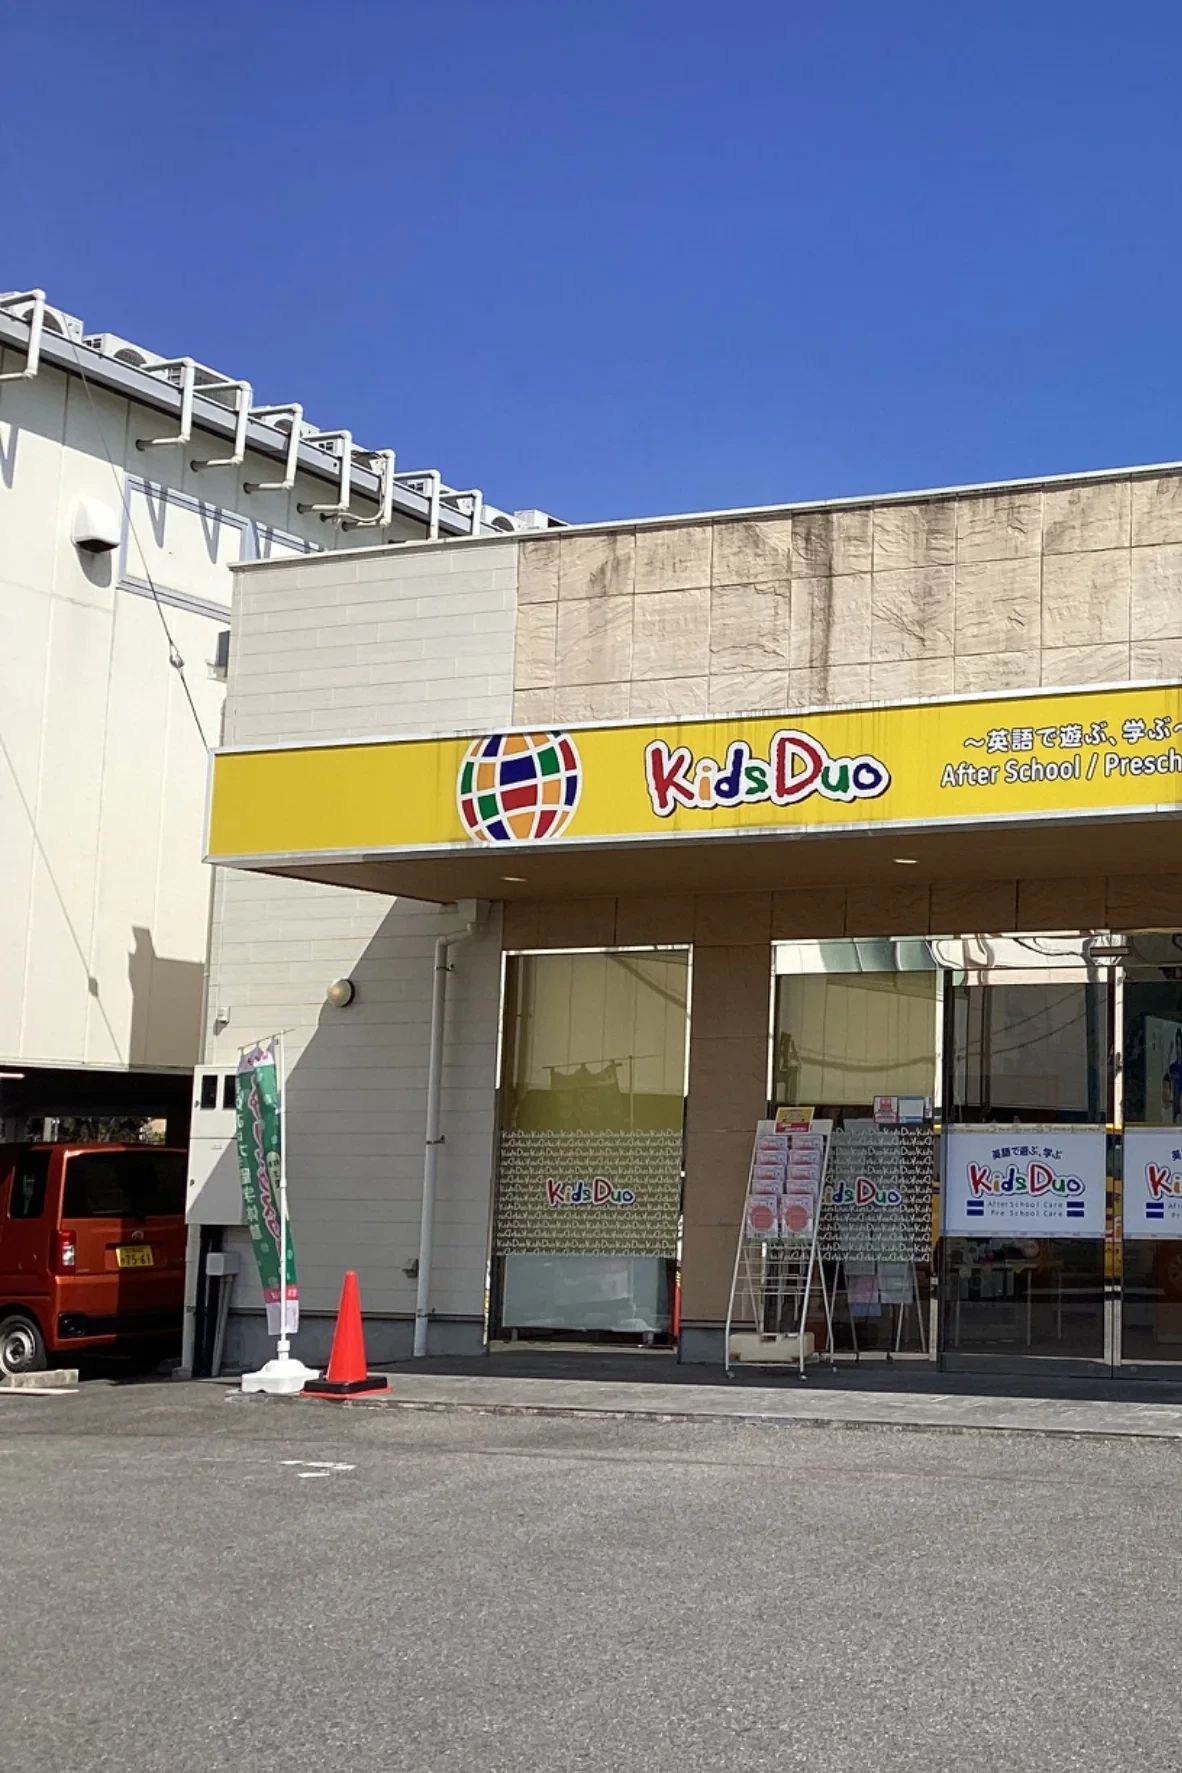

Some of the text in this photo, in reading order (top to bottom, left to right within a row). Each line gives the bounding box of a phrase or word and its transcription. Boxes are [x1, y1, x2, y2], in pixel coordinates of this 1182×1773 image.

[940, 762, 998, 788] After
[1003, 754, 1081, 783] School
[1085, 753, 1098, 780] /
